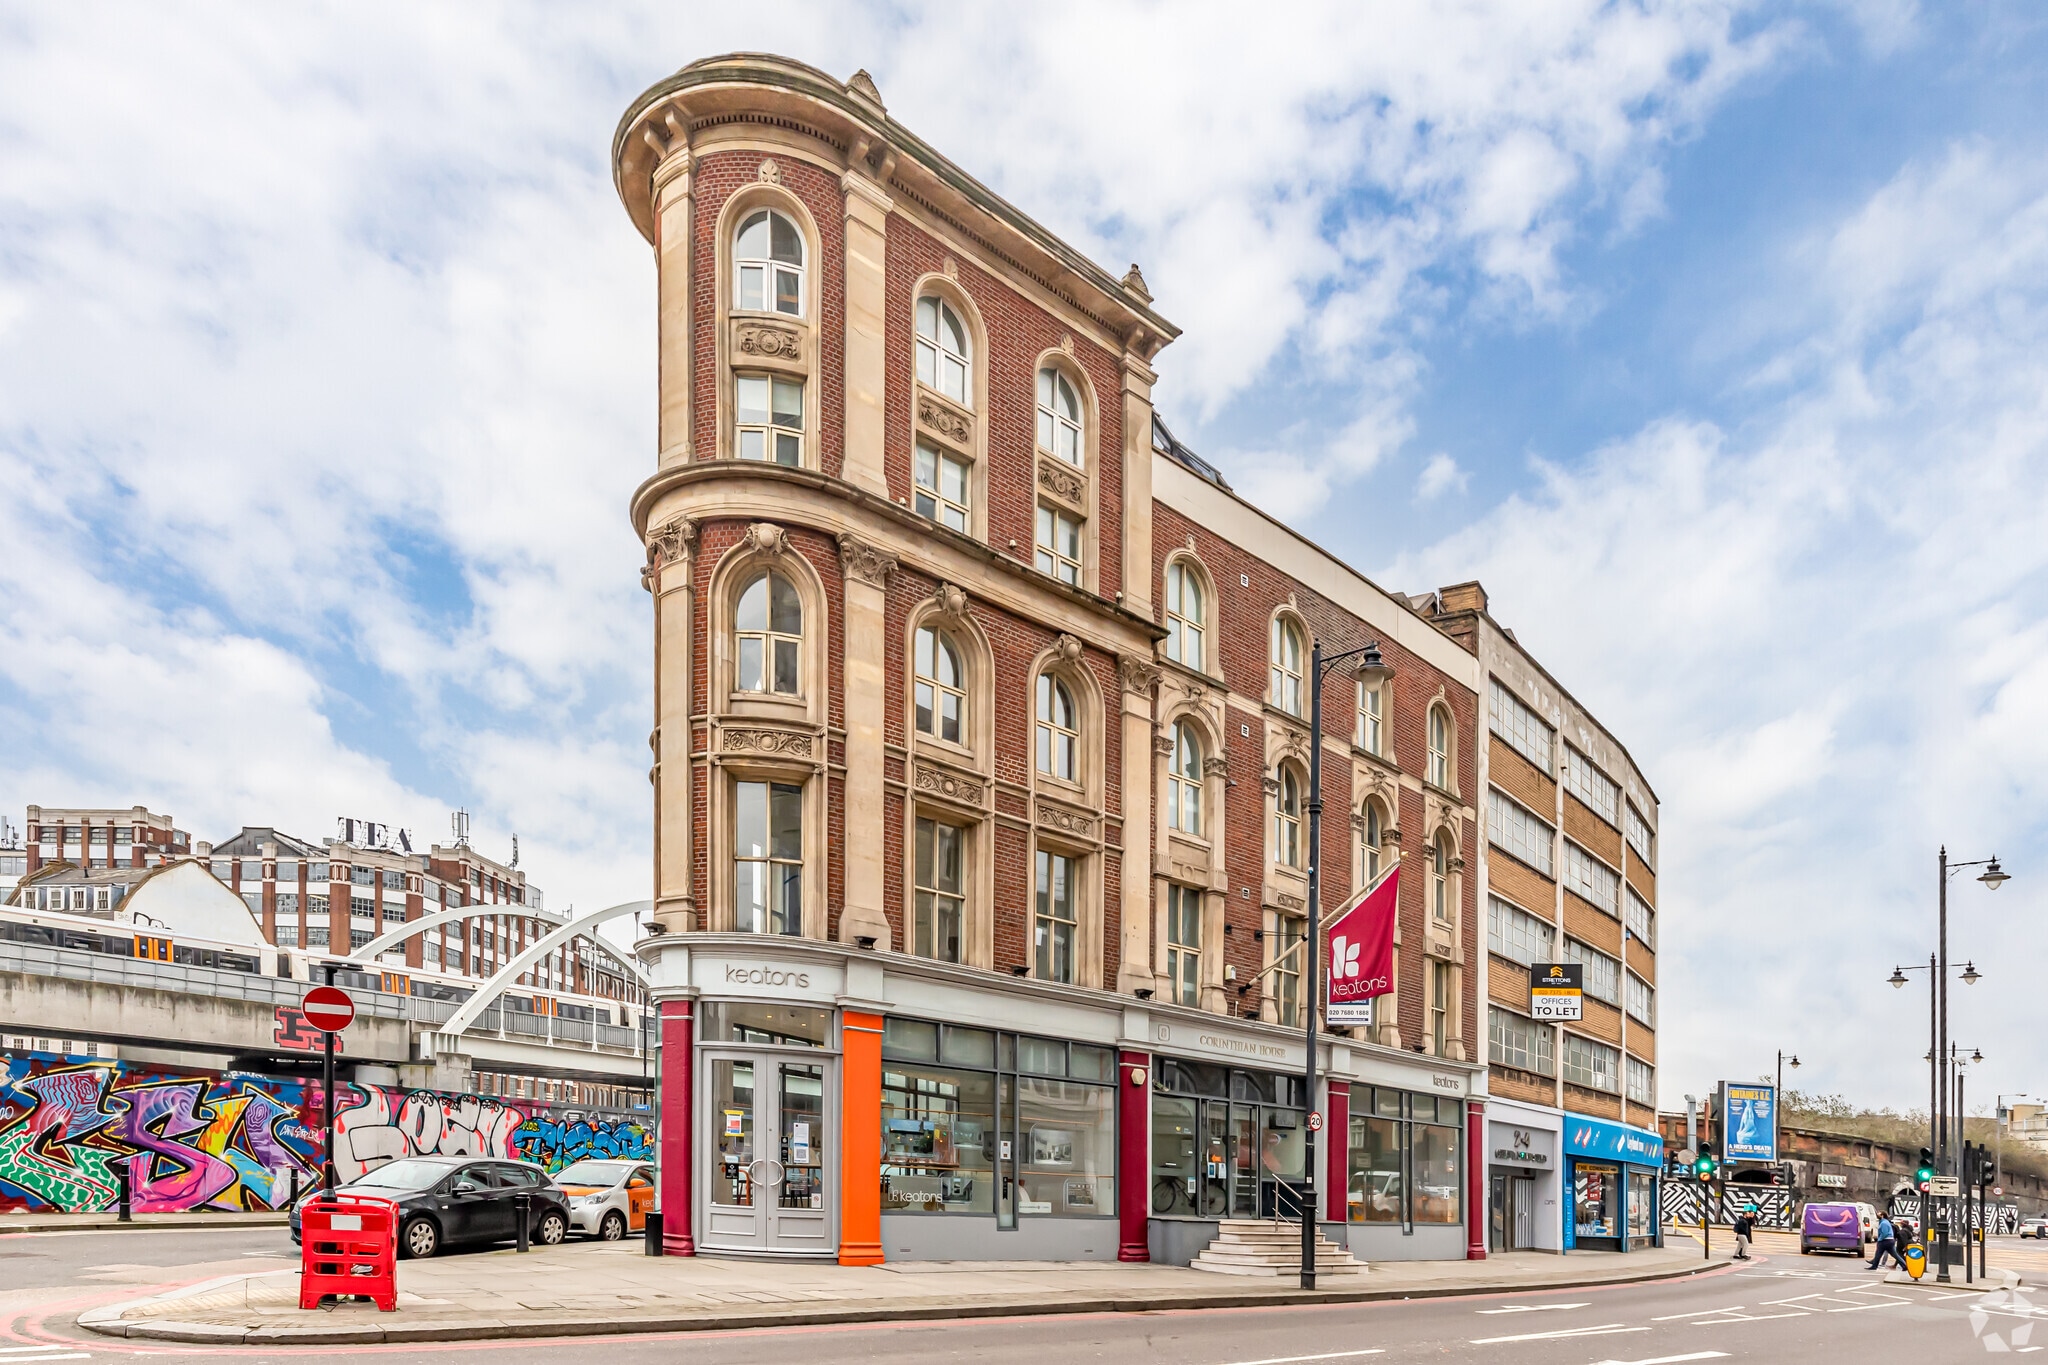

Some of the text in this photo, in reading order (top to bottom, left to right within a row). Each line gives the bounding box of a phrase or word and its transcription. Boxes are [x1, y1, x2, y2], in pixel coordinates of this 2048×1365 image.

[338, 816, 413, 853] TEA
[726, 964, 810, 988] keatons
[1333, 975, 1388, 996] keatons
[1535, 1006, 1578, 1016] TO LET
[1200, 1035, 1286, 1057] CORINTHIAN HOUSE
[1433, 1074, 1459, 1090] keatons
[1312, 1117, 1320, 1126] 20
[900, 1190, 942, 1202] keatons
